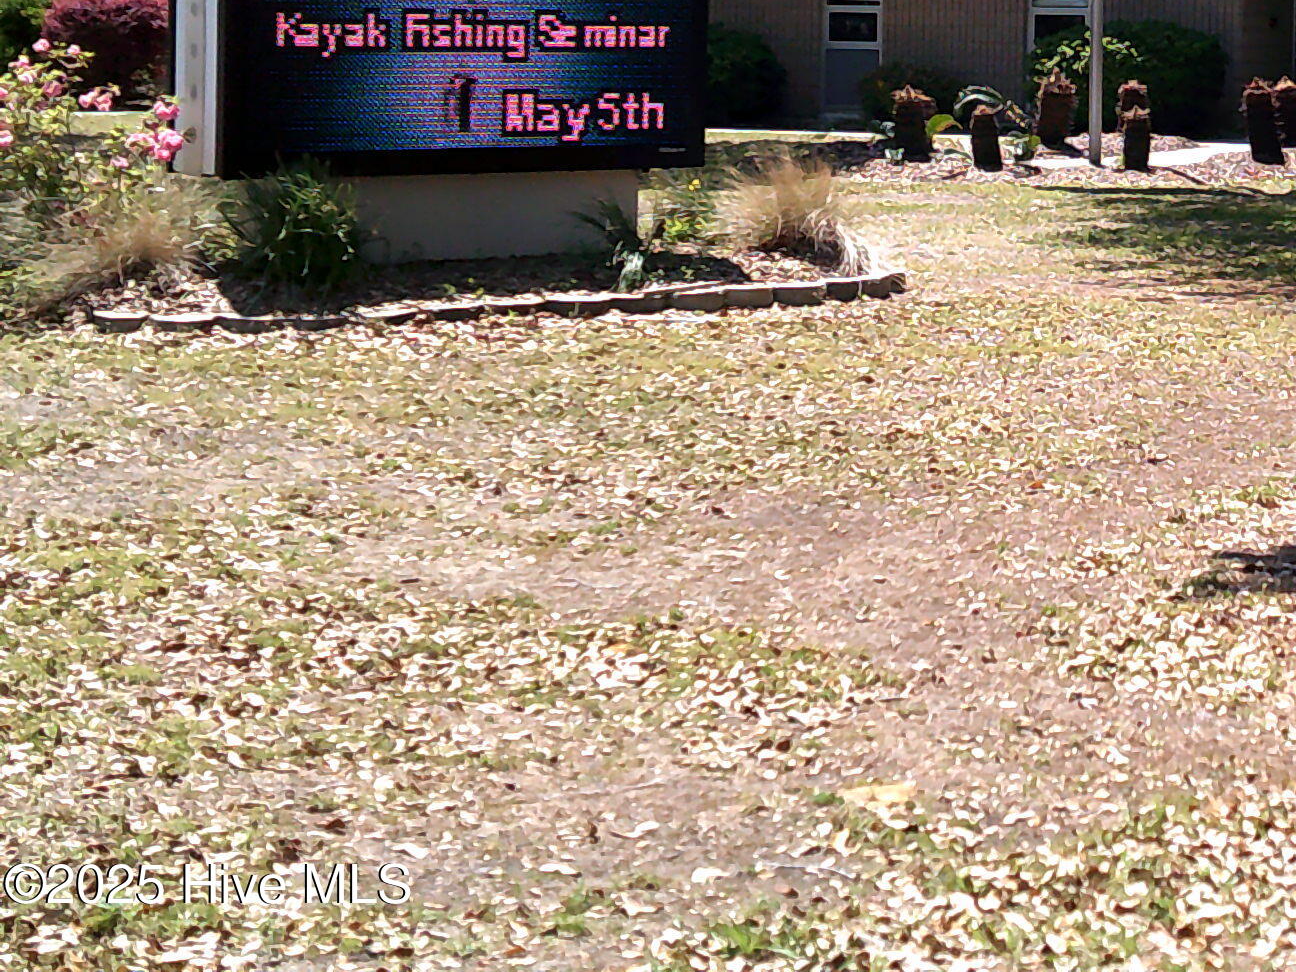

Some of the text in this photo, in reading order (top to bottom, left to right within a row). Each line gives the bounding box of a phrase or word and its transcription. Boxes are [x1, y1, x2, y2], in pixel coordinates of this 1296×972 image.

[275, 11, 671, 58] Kayak Fishing Seminar
[505, 92, 665, 142] May 5th
